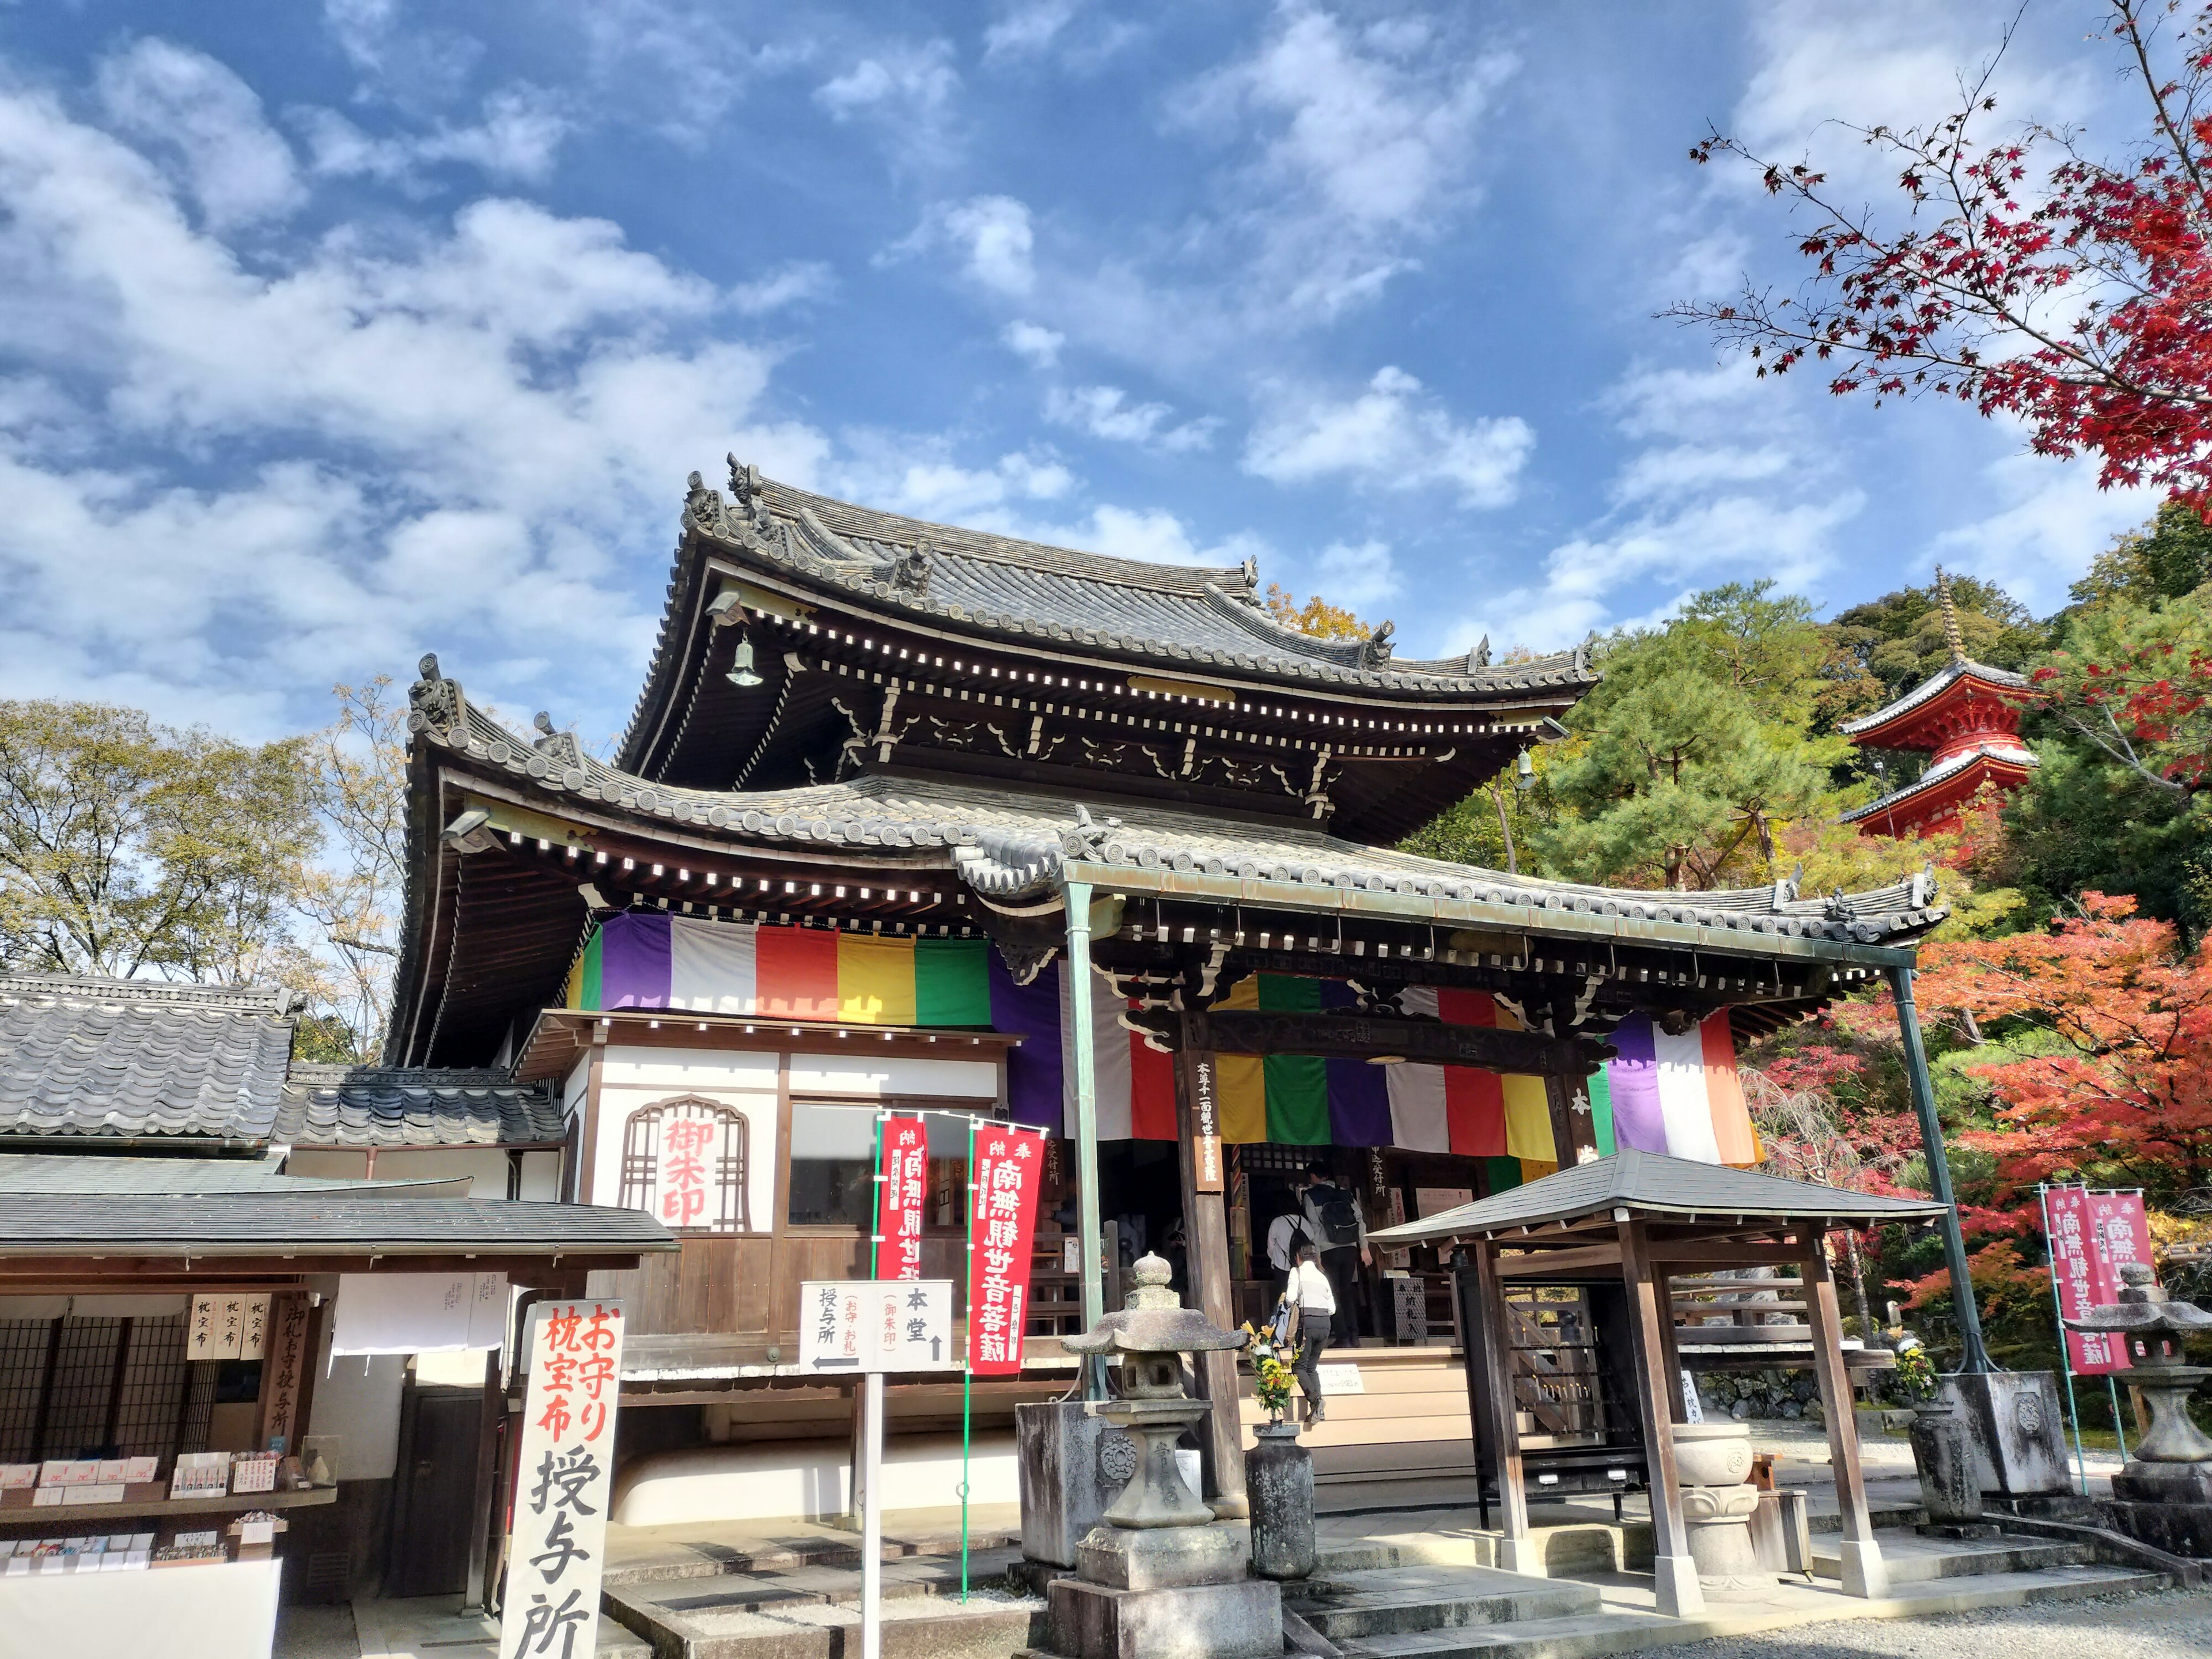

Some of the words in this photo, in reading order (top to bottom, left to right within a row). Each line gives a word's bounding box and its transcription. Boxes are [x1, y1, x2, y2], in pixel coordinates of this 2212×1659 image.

[662, 1118, 714, 1226] 御朱印
[195, 1301, 211, 1349] 枕宝布
[224, 1301, 239, 1348] 枕宝布
[249, 1302, 264, 1349] 枕宝布
[817, 1287, 838, 1344] 授与所
[906, 1287, 929, 1343] 本堂
[1406, 1296, 1418, 1334] 納札入
[271, 1305, 305, 1437] 御札お守授与所
[536, 1305, 582, 1443] 枕宝布
[578, 1304, 620, 1441] お守り
[513, 1444, 601, 1659] 授与所
